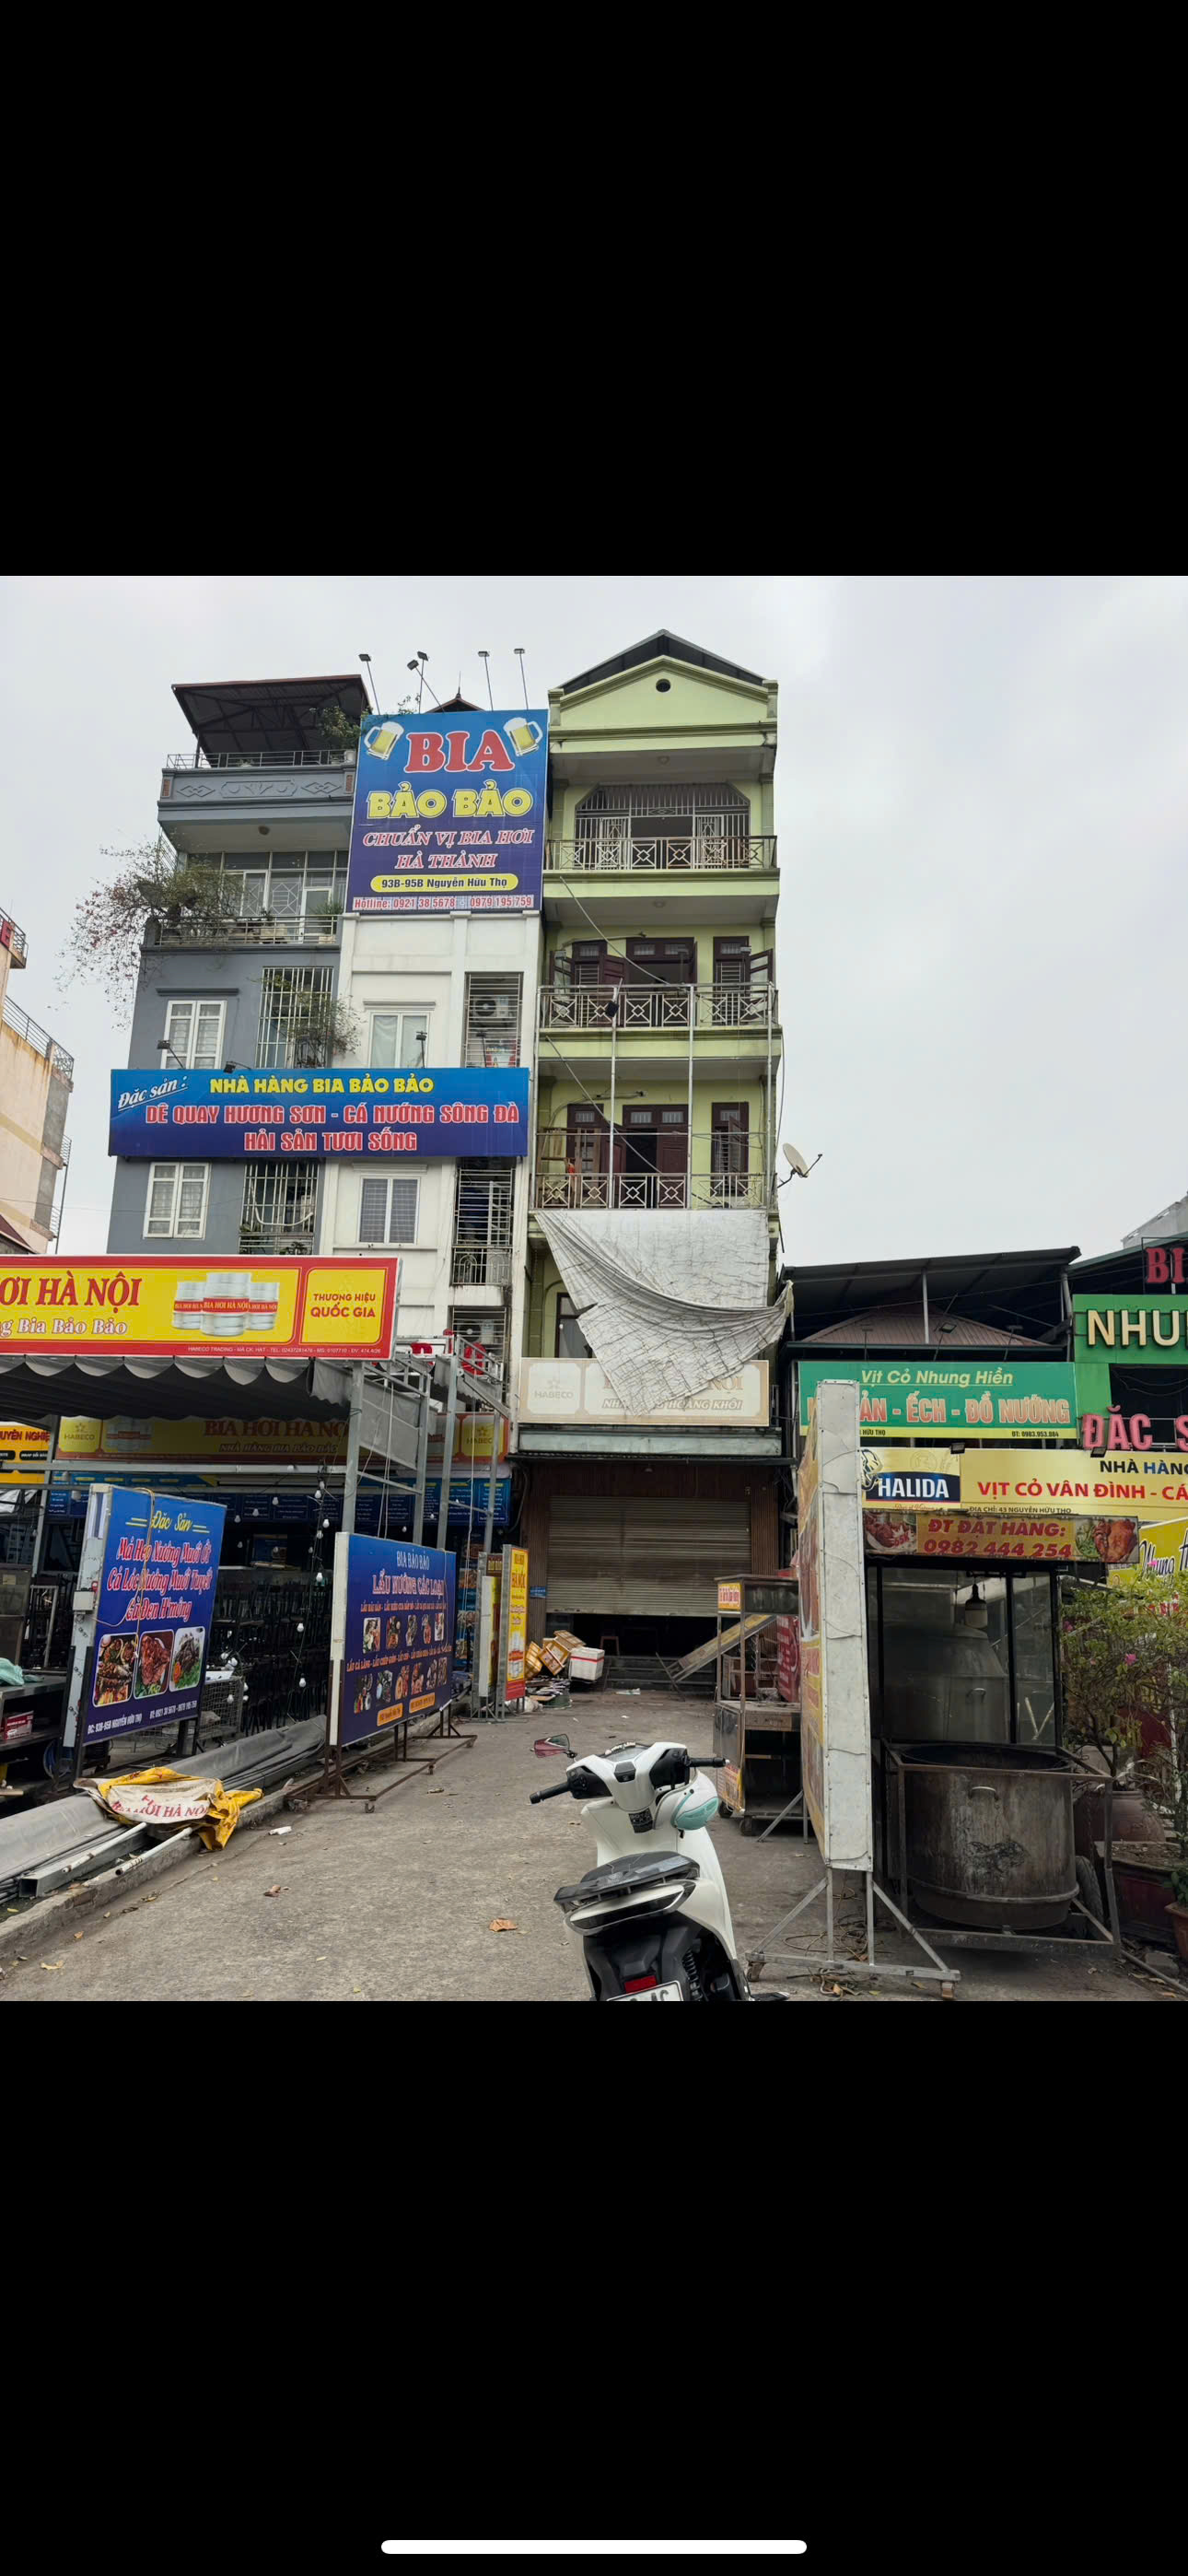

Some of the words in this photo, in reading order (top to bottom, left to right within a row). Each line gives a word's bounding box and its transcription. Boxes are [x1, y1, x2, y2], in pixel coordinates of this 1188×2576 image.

[404, 730, 515, 773] BIA
[367, 781, 447, 819] BẢO
[452, 779, 532, 817] BẢO
[363, 825, 431, 847] CHUẨN
[436, 832, 456, 848] VỊ
[458, 831, 492, 845] BIA
[495, 828, 534, 844] HƠI
[395, 850, 424, 869] HÀ
[428, 850, 498, 869] THÀNH
[381, 878, 424, 889] 93B-95B
[426, 877, 464, 890] Nguyễn
[467, 877, 486, 887] Hữu
[490, 878, 507, 889] Thọ
[355, 897, 390, 909] Hotline:
[393, 897, 414, 908] 0921
[419, 898, 430, 908] 38
[433, 897, 456, 907] 5678
[470, 897, 493, 907] 0979
[495, 897, 512, 907] 195
[515, 896, 532, 907] 759
[118, 1087, 146, 1108] Đặc
[149, 1078, 178, 1098] sản
[210, 1075, 250, 1094] NHÀ
[254, 1075, 309, 1094] HÀNG
[313, 1078, 344, 1093] BIA
[349, 1073, 390, 1094] BẢO
[393, 1073, 434, 1093] BẢO
[146, 1102, 168, 1124] DÊ
[172, 1105, 220, 1125] QUAY
[224, 1105, 285, 1124] HƯƠNG
[289, 1105, 326, 1124] SƠN
[344, 1102, 368, 1123] CÁ
[373, 1102, 435, 1123] NƯỚNG
[439, 1102, 489, 1123] SÔNG
[494, 1101, 519, 1123] ĐÀ
[244, 1128, 275, 1151] HẢI
[280, 1128, 318, 1151] SẢN
[322, 1132, 363, 1151] TƯƠI
[368, 1126, 417, 1151] SỐNG
[1146, 1247, 1188, 1283] BI
[0, 1276, 31, 1306] ƠI
[35, 1270, 78, 1306] HÀ
[84, 1270, 142, 1314] NỘI
[313, 1294, 352, 1302] THƯƠNG
[355, 1292, 376, 1303] HIỆU
[310, 1302, 350, 1317] QUỐC
[353, 1306, 376, 1317] GIA
[17, 1317, 46, 1334] Bia
[52, 1317, 87, 1335] Bảo
[92, 1317, 127, 1335] Bảo
[1087, 1308, 1188, 1346] NHU
[861, 1370, 883, 1387] Vịt
[887, 1368, 911, 1384] Cỏ
[916, 1371, 971, 1388] Nhung
[975, 1366, 1013, 1385] Hiền
[859, 1389, 887, 1422] ẢN
[906, 1390, 946, 1423] ẾCH
[998, 1394, 1071, 1423] NƯỚNG
[0, 1429, 22, 1440] UYÊN
[26, 1430, 51, 1443] NGHIỆ
[1176, 1415, 1188, 1452] S
[1100, 1458, 1139, 1473] NHÀ
[878, 1478, 949, 1498] HALIDA
[977, 1481, 1010, 1500] VỊT
[1015, 1478, 1043, 1496] CỎ
[1046, 1480, 1089, 1497] VÂN
[1093, 1481, 1146, 1499] ĐÌNH
[928, 1518, 954, 1534] ĐT
[1002, 1518, 1066, 1537] HÀNG:
[924, 1540, 978, 1554] 0982
[984, 1540, 1024, 1556] 444
[1032, 1542, 1072, 1557] 254
